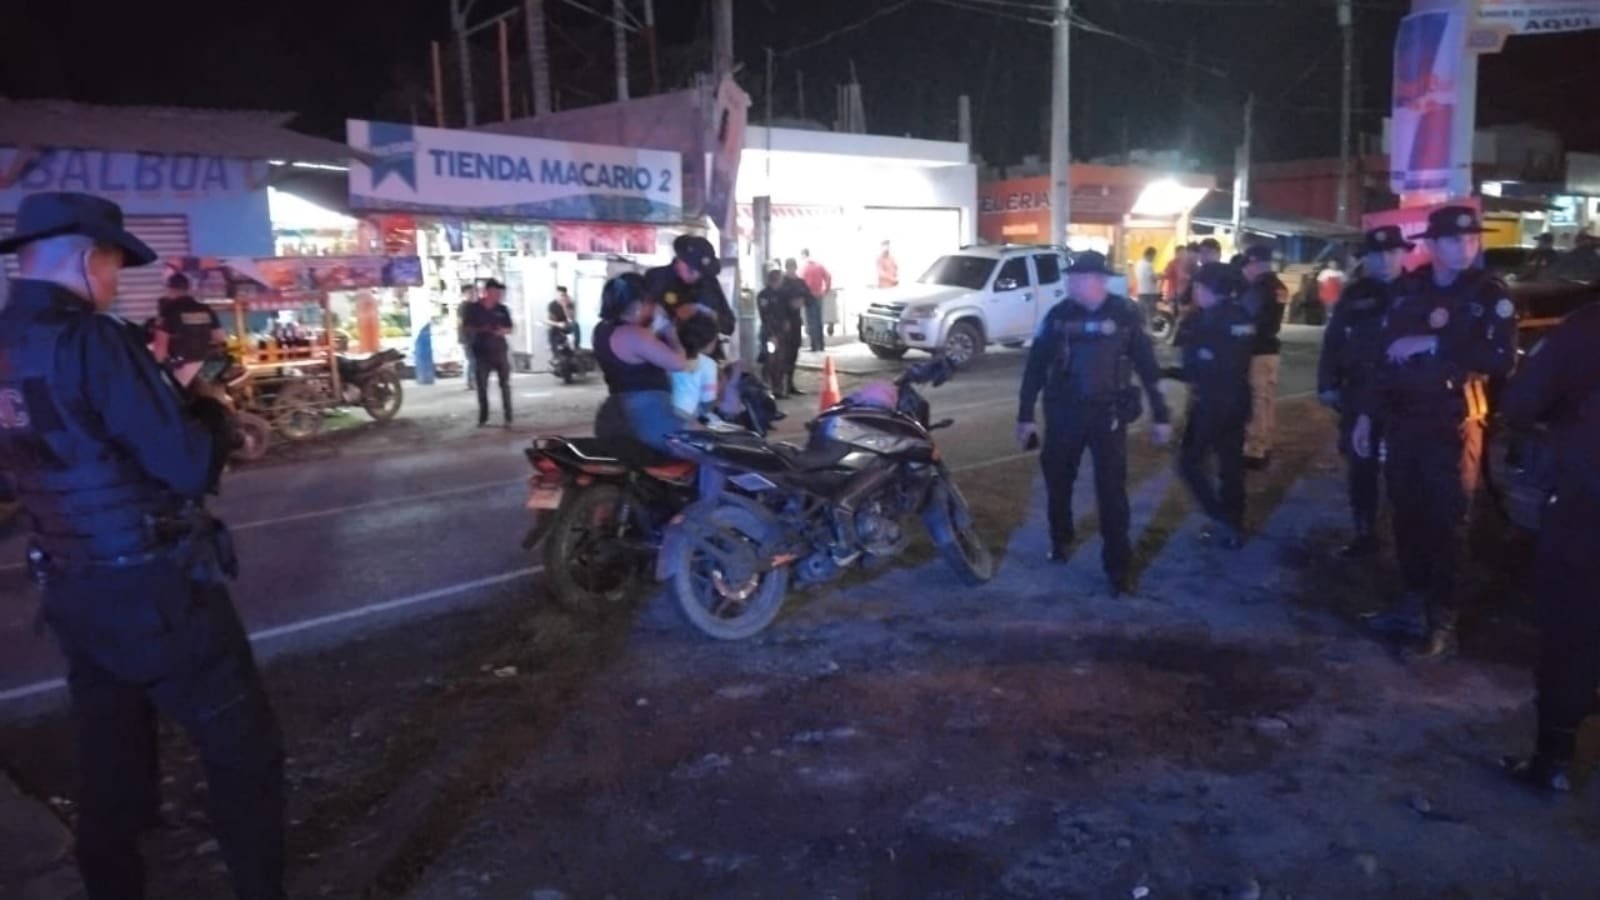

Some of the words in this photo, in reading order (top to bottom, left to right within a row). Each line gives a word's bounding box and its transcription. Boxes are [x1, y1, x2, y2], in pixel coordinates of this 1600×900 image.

[429, 149, 533, 183] TIENDA
[540, 159, 652, 192] MACARIO
[658, 169, 673, 192] 2
